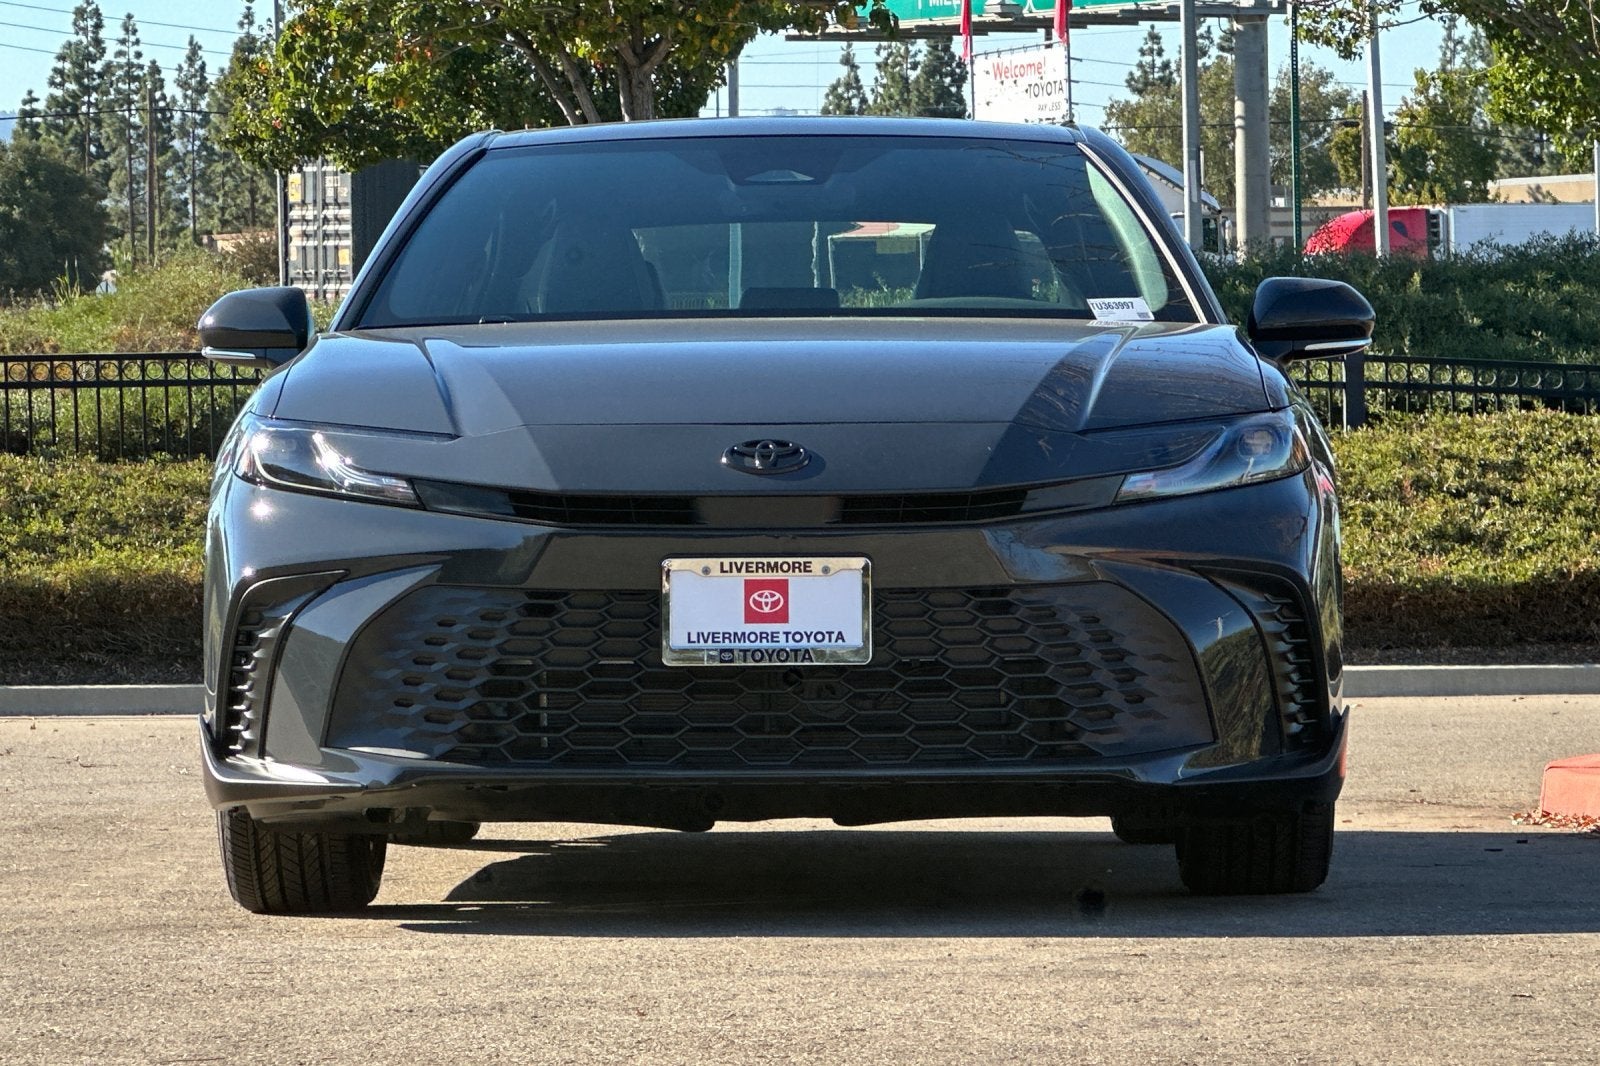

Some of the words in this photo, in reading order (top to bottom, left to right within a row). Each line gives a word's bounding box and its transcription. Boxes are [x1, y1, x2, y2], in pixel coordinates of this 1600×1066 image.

[992, 56, 1046, 80] Welcome!
[1028, 80, 1064, 99] TOYOTA
[1090, 301, 1135, 310] TU363997
[719, 561, 812, 573] LIVERMORE
[687, 632, 780, 644] LIVERMORE
[783, 631, 846, 643] TOYOTA
[742, 649, 814, 663] TOYOTA
